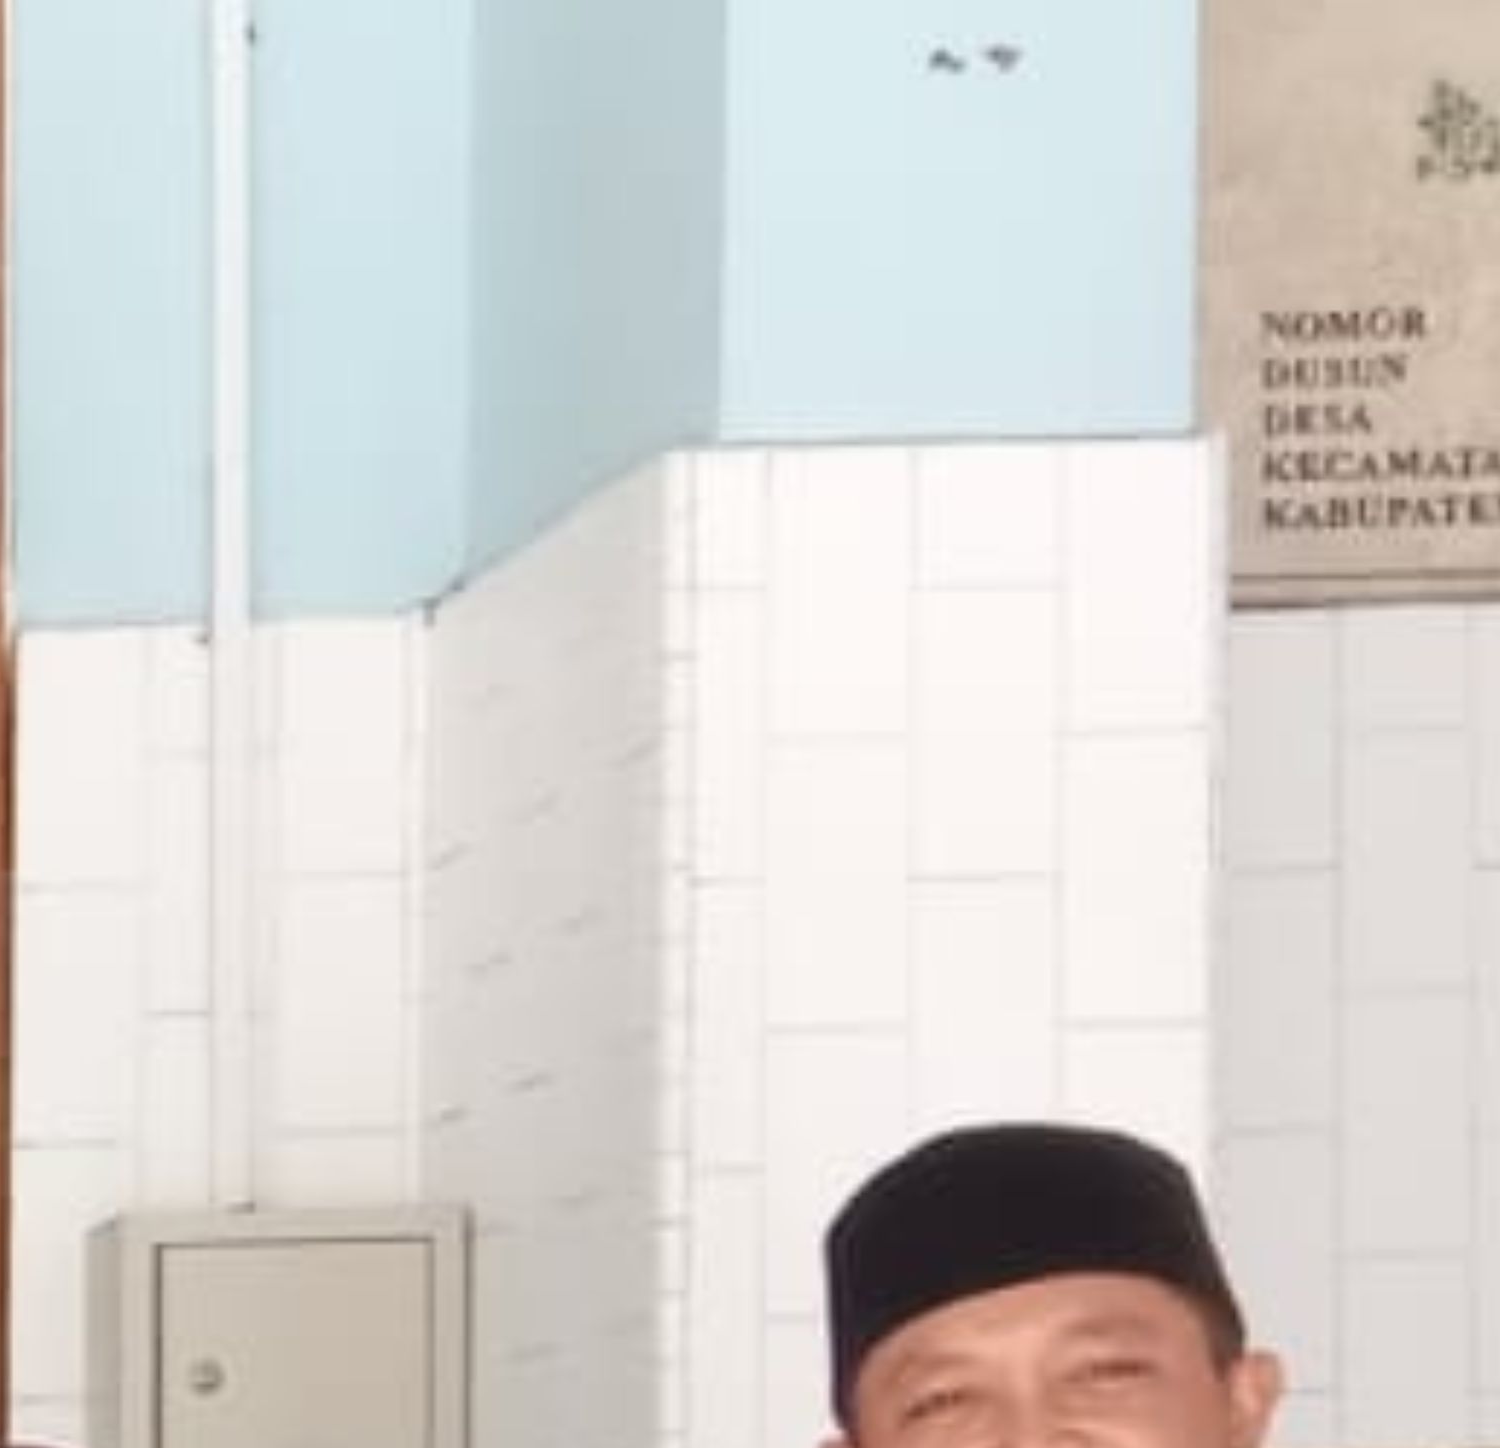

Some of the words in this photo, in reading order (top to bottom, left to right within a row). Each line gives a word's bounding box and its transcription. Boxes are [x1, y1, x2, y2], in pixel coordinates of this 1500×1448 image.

[1261, 307, 1425, 341] NOMOR
[1262, 354, 1407, 389] DUSUN
[1263, 402, 1373, 437] DESA
[1264, 496, 1500, 530] KABUPATE
